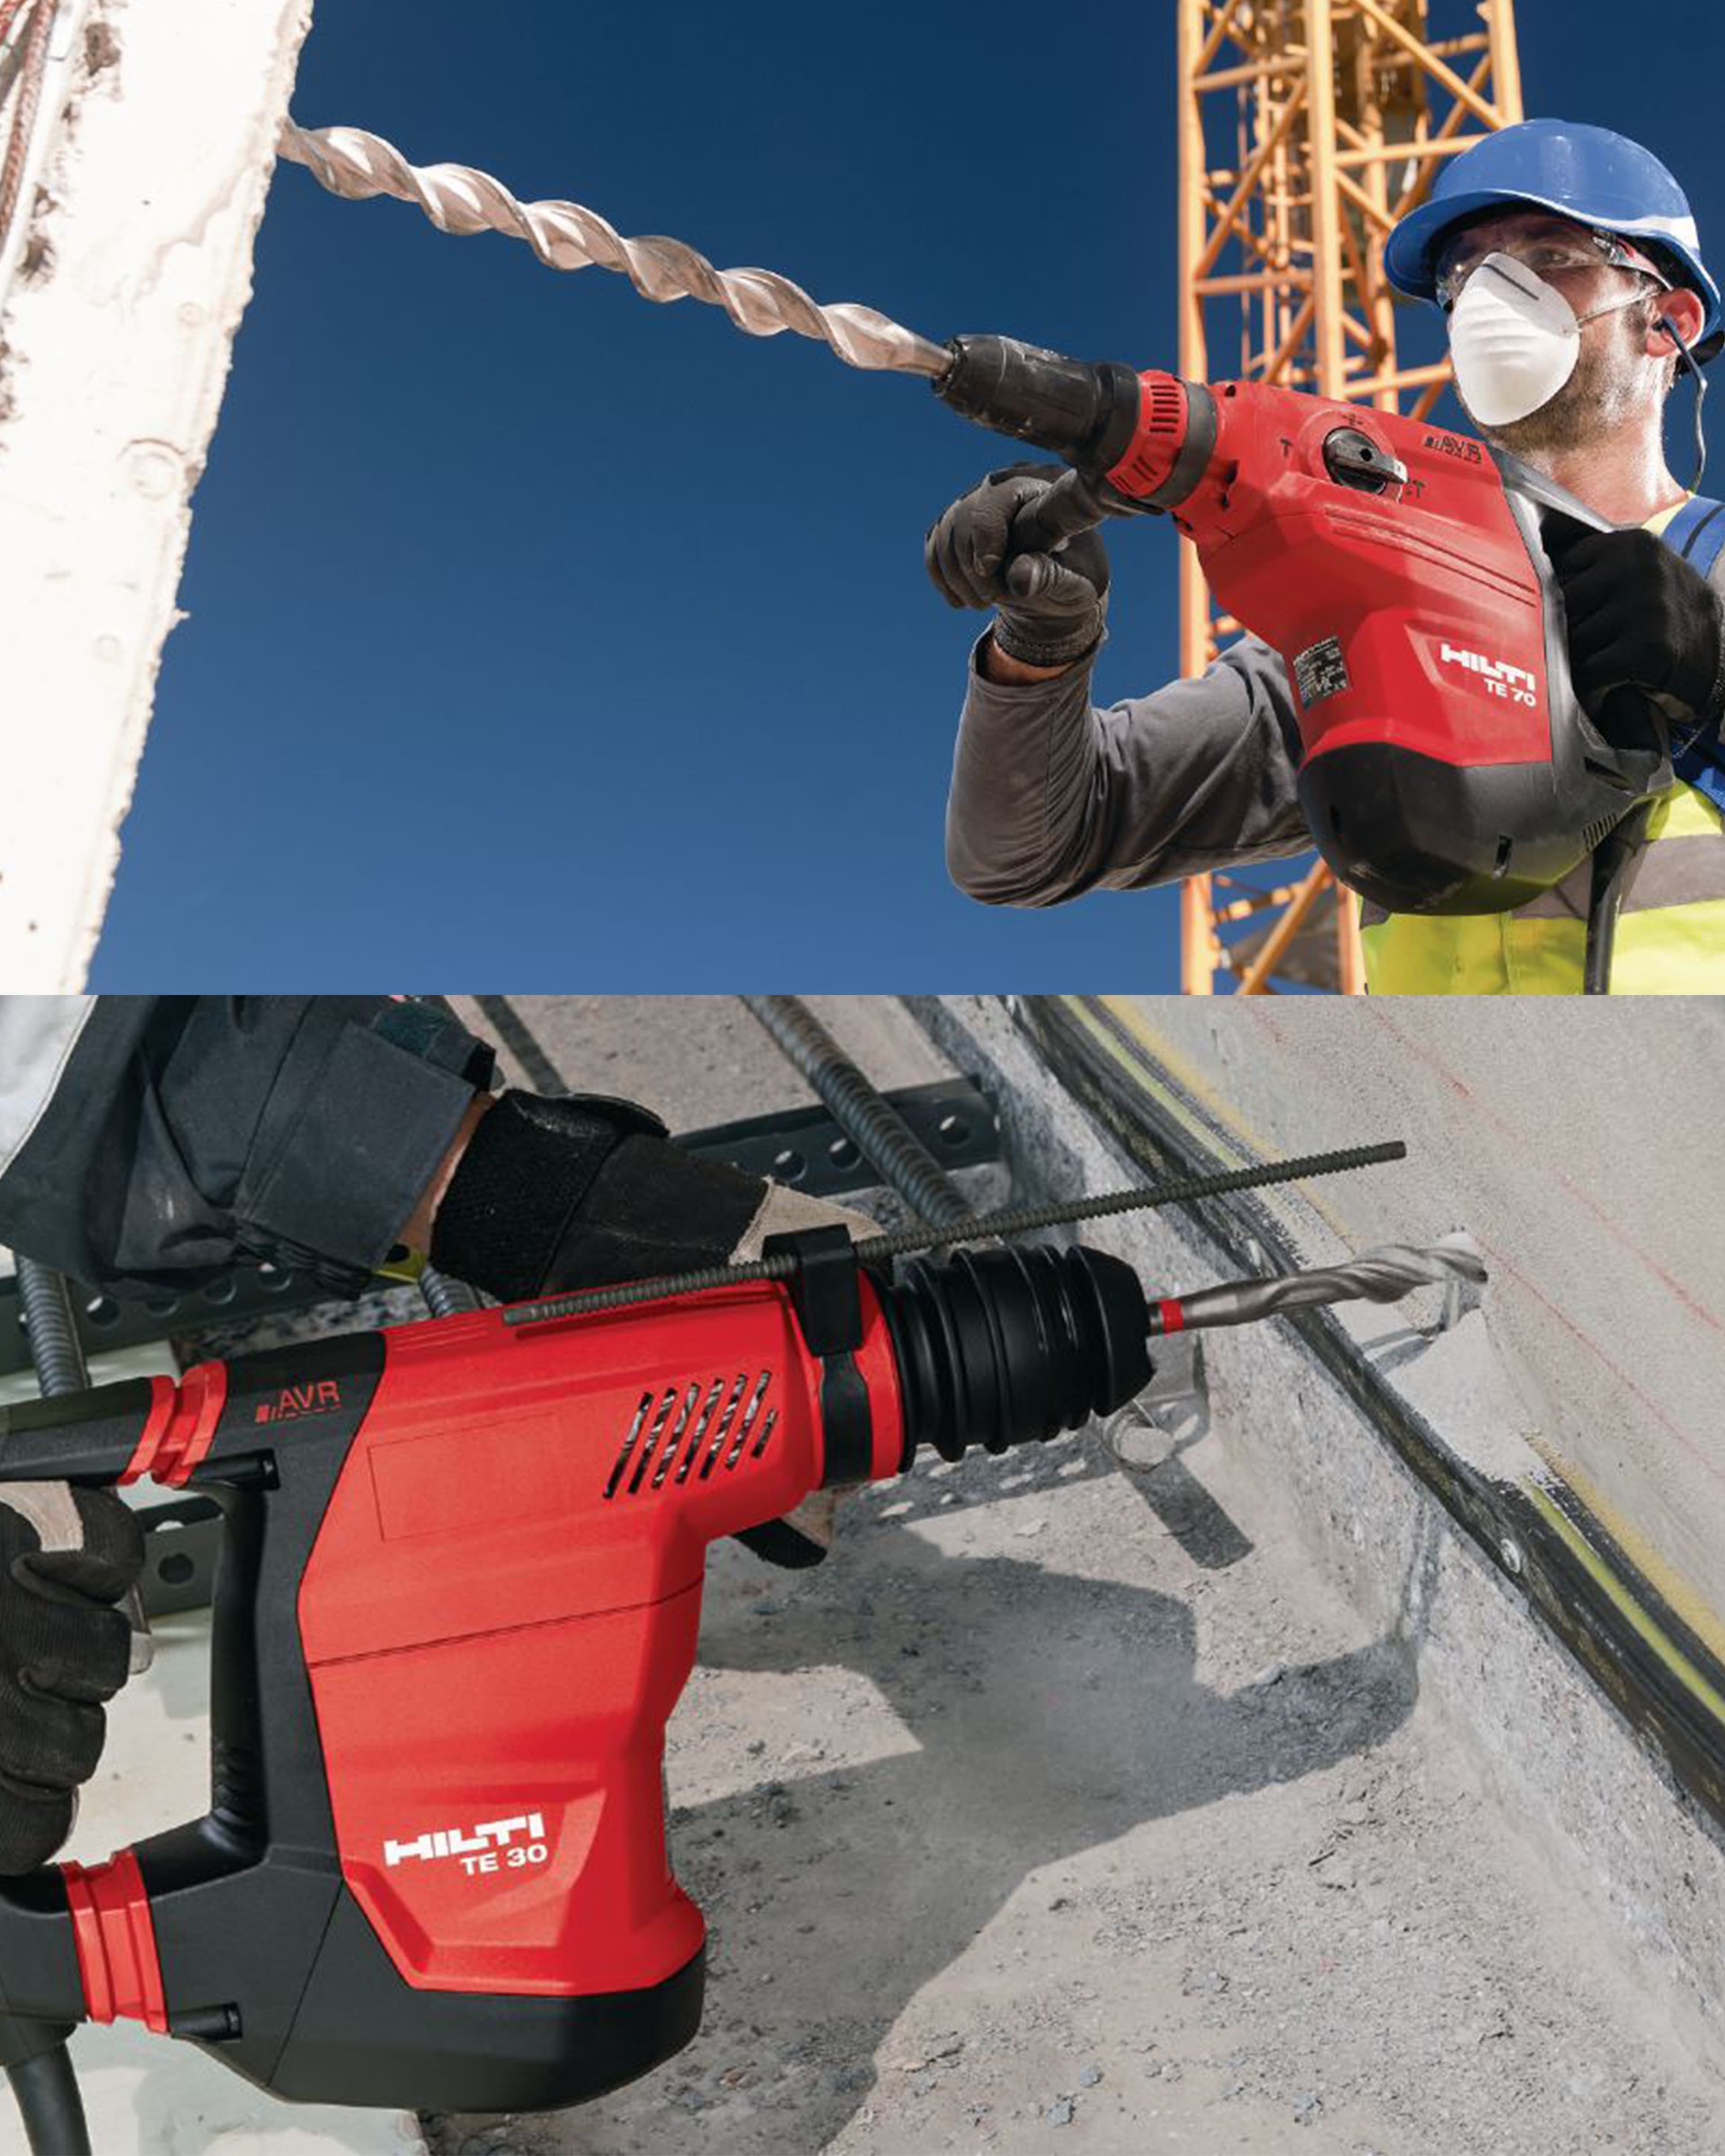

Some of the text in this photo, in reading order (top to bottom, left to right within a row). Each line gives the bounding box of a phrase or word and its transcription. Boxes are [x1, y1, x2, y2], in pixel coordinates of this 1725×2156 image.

[1441, 643, 1535, 692] HILTI
[1484, 678, 1536, 707] TE 70
[279, 1381, 341, 1410] AVR
[383, 1813, 545, 1866] HILTI
[461, 1844, 548, 1875] TE 30
